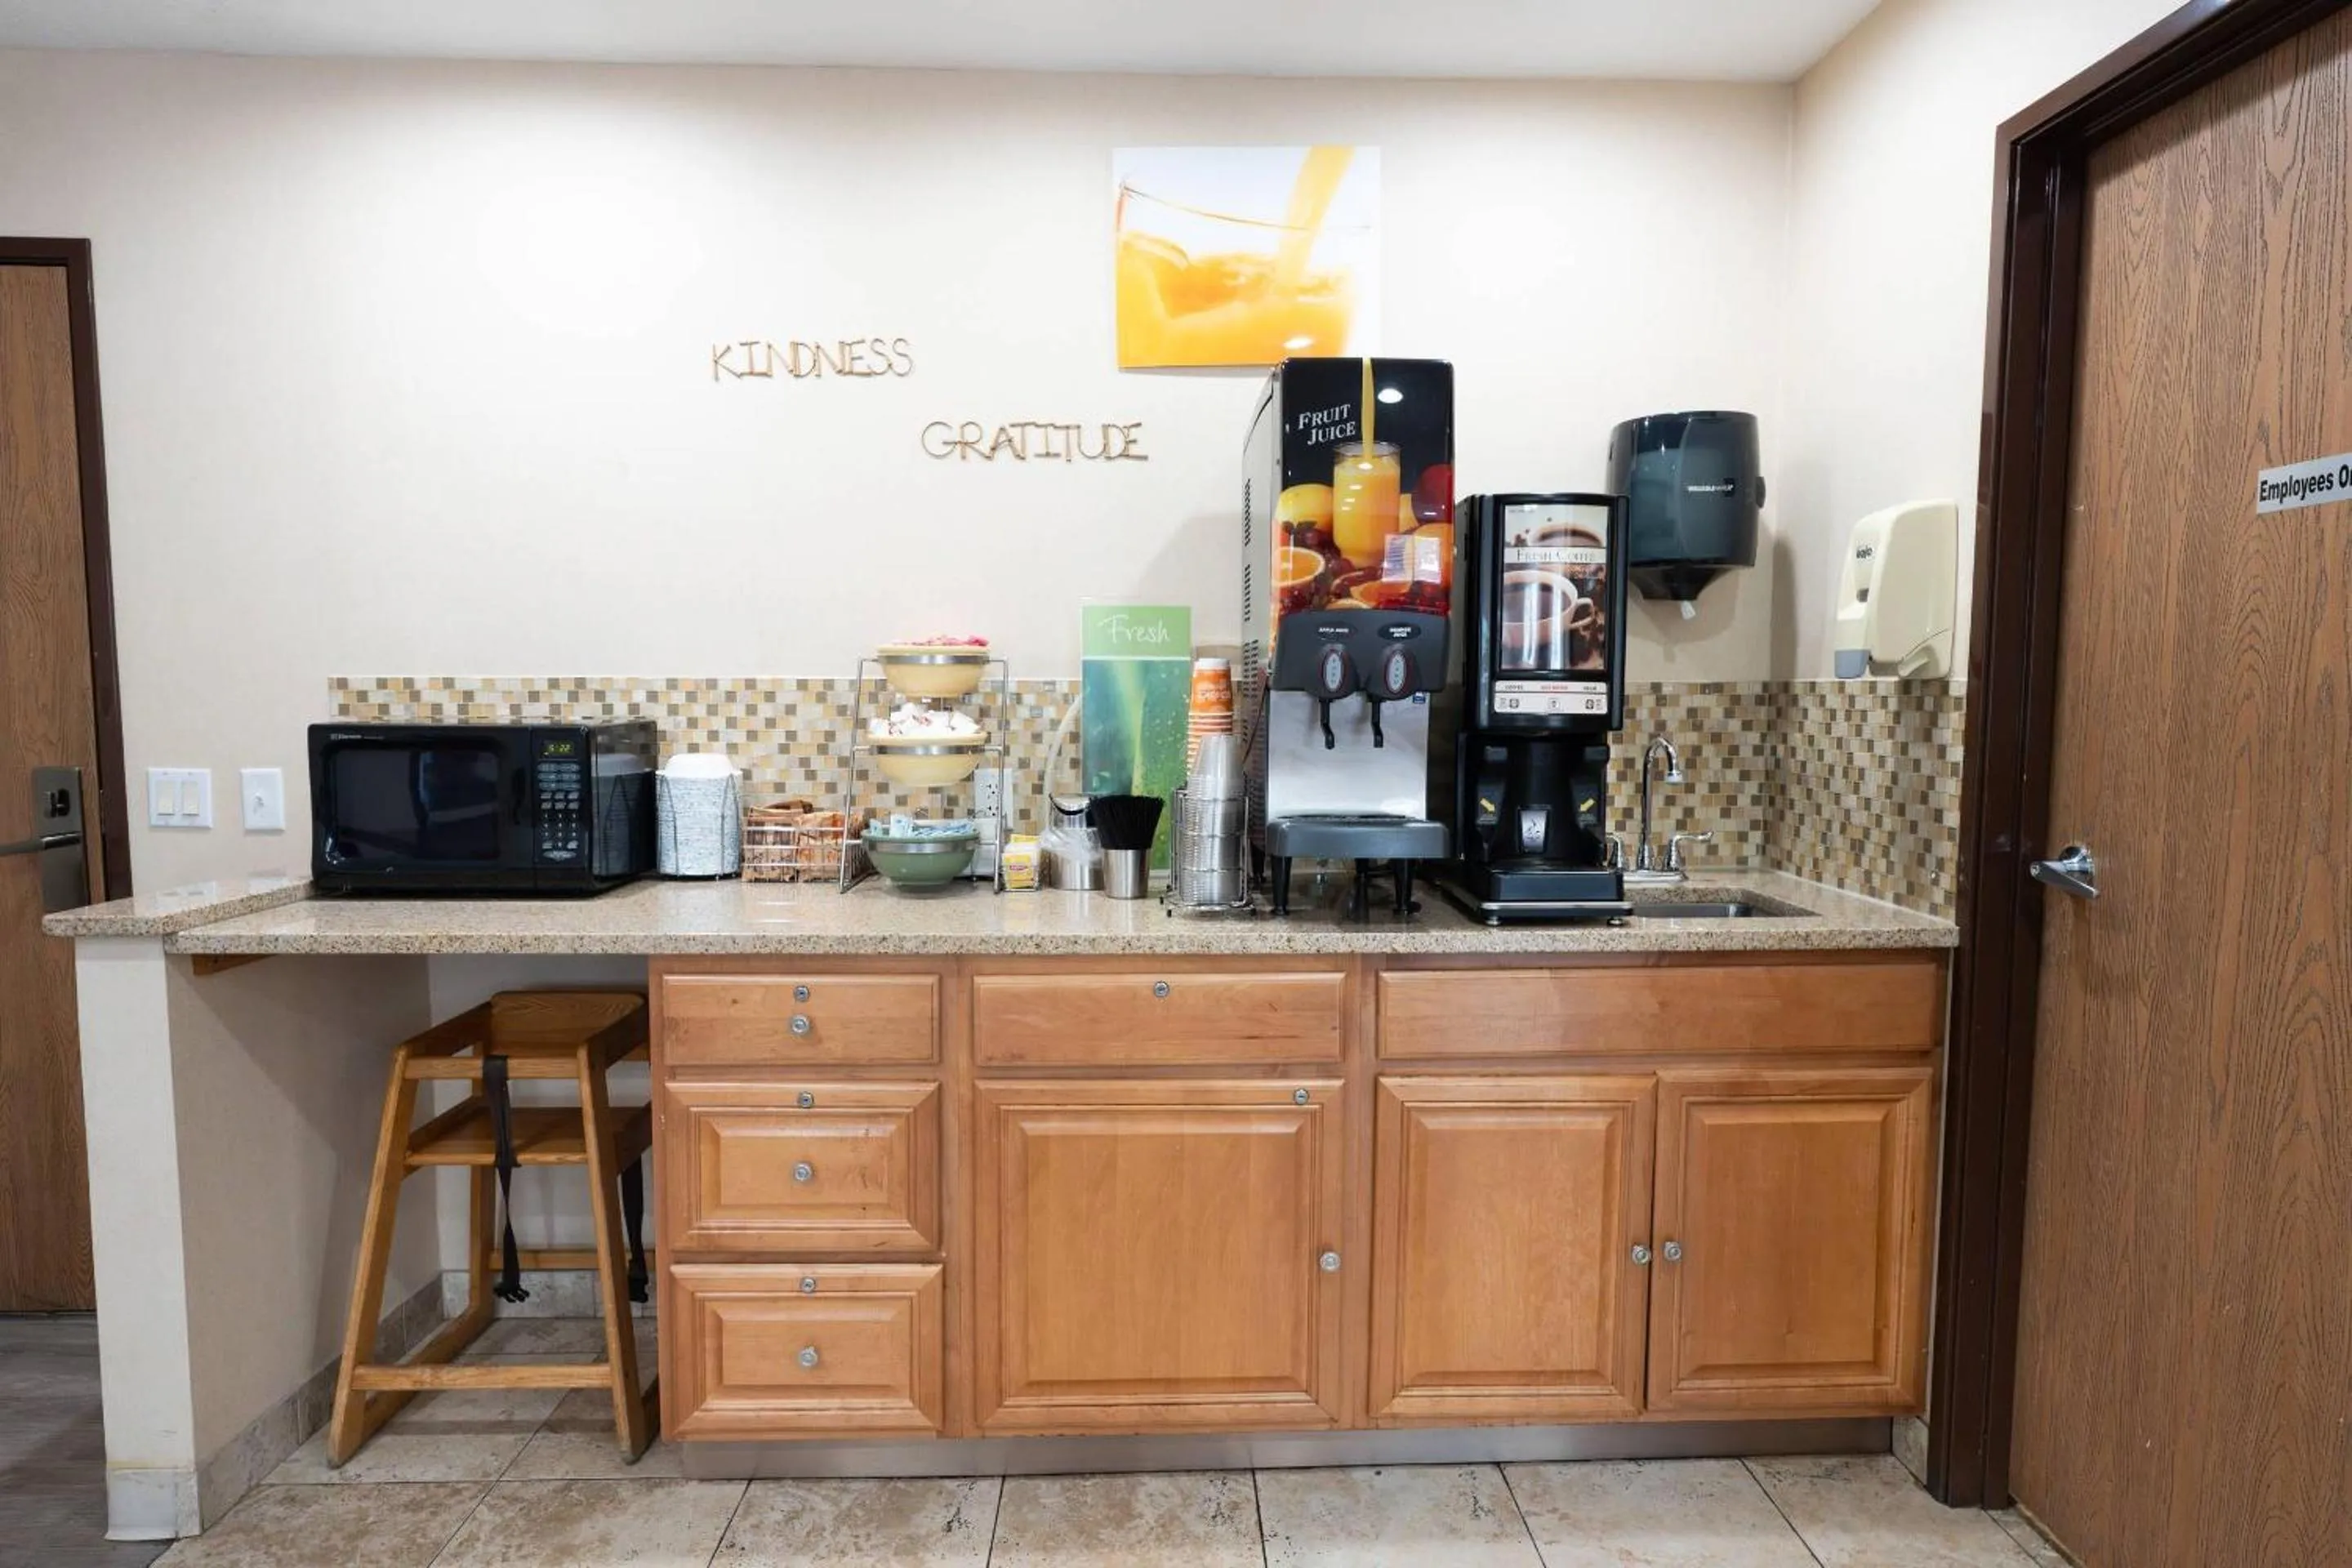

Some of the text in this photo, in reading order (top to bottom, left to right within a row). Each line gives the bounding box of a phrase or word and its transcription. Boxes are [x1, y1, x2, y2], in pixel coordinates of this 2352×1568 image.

[713, 338, 913, 381] KINDNESS
[1298, 403, 1351, 430] FRUIT
[1307, 421, 1356, 445] JUICE
[921, 421, 1148, 462] GRATITUDE
[2259, 464, 2352, 504] Employees O
[1098, 614, 1170, 644] Fresh
